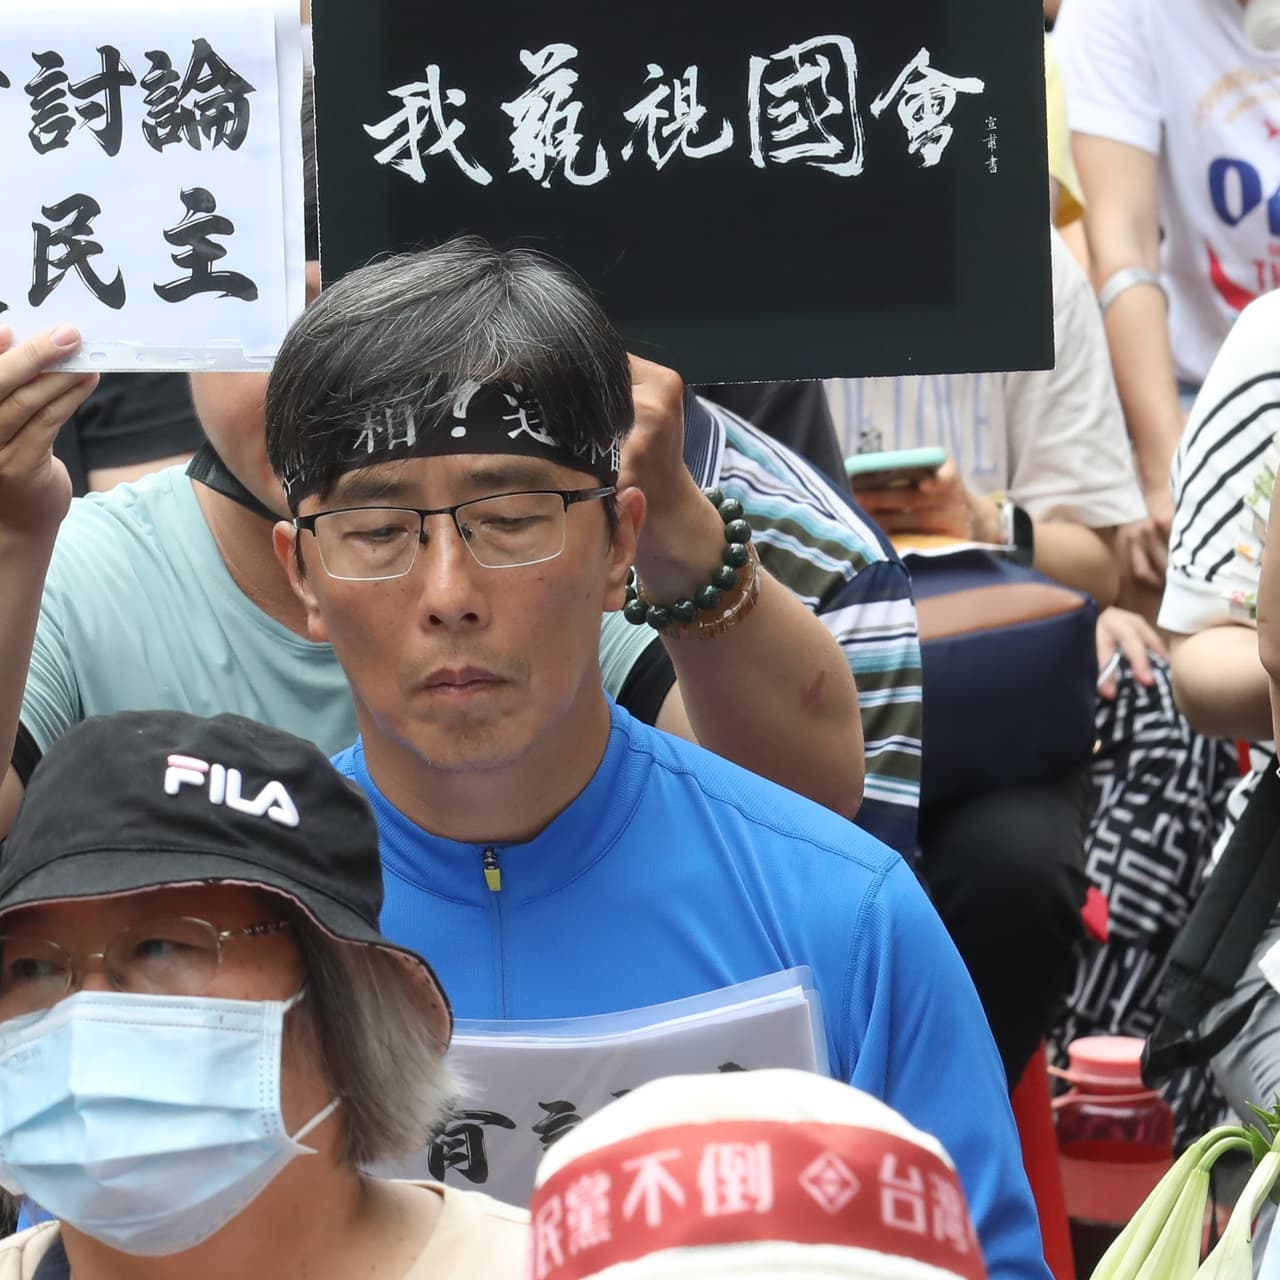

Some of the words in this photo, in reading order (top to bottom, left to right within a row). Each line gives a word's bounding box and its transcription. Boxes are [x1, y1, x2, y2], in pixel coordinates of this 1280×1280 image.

[362, 34, 985, 189] 我藐視國會
[163, 754, 300, 827] FILA
